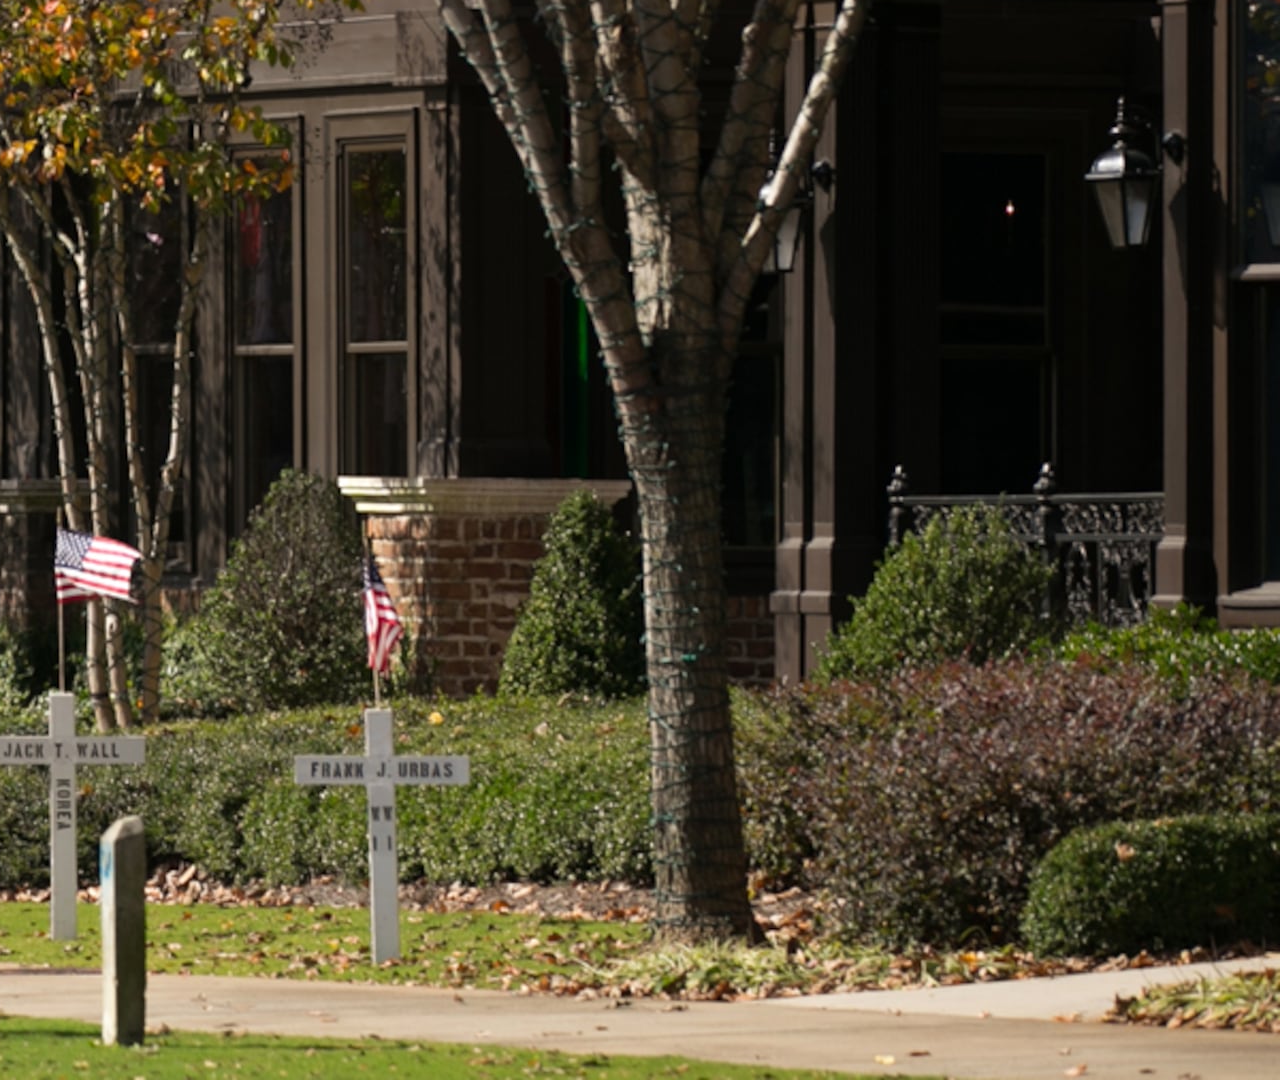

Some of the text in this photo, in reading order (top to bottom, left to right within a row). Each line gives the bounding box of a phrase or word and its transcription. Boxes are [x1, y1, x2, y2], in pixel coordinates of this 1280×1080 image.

[3, 743, 120, 759] JACK T. WALL
[311, 762, 454, 778] FRANK J. URBAS
[56, 778, 71, 831] KOREA
